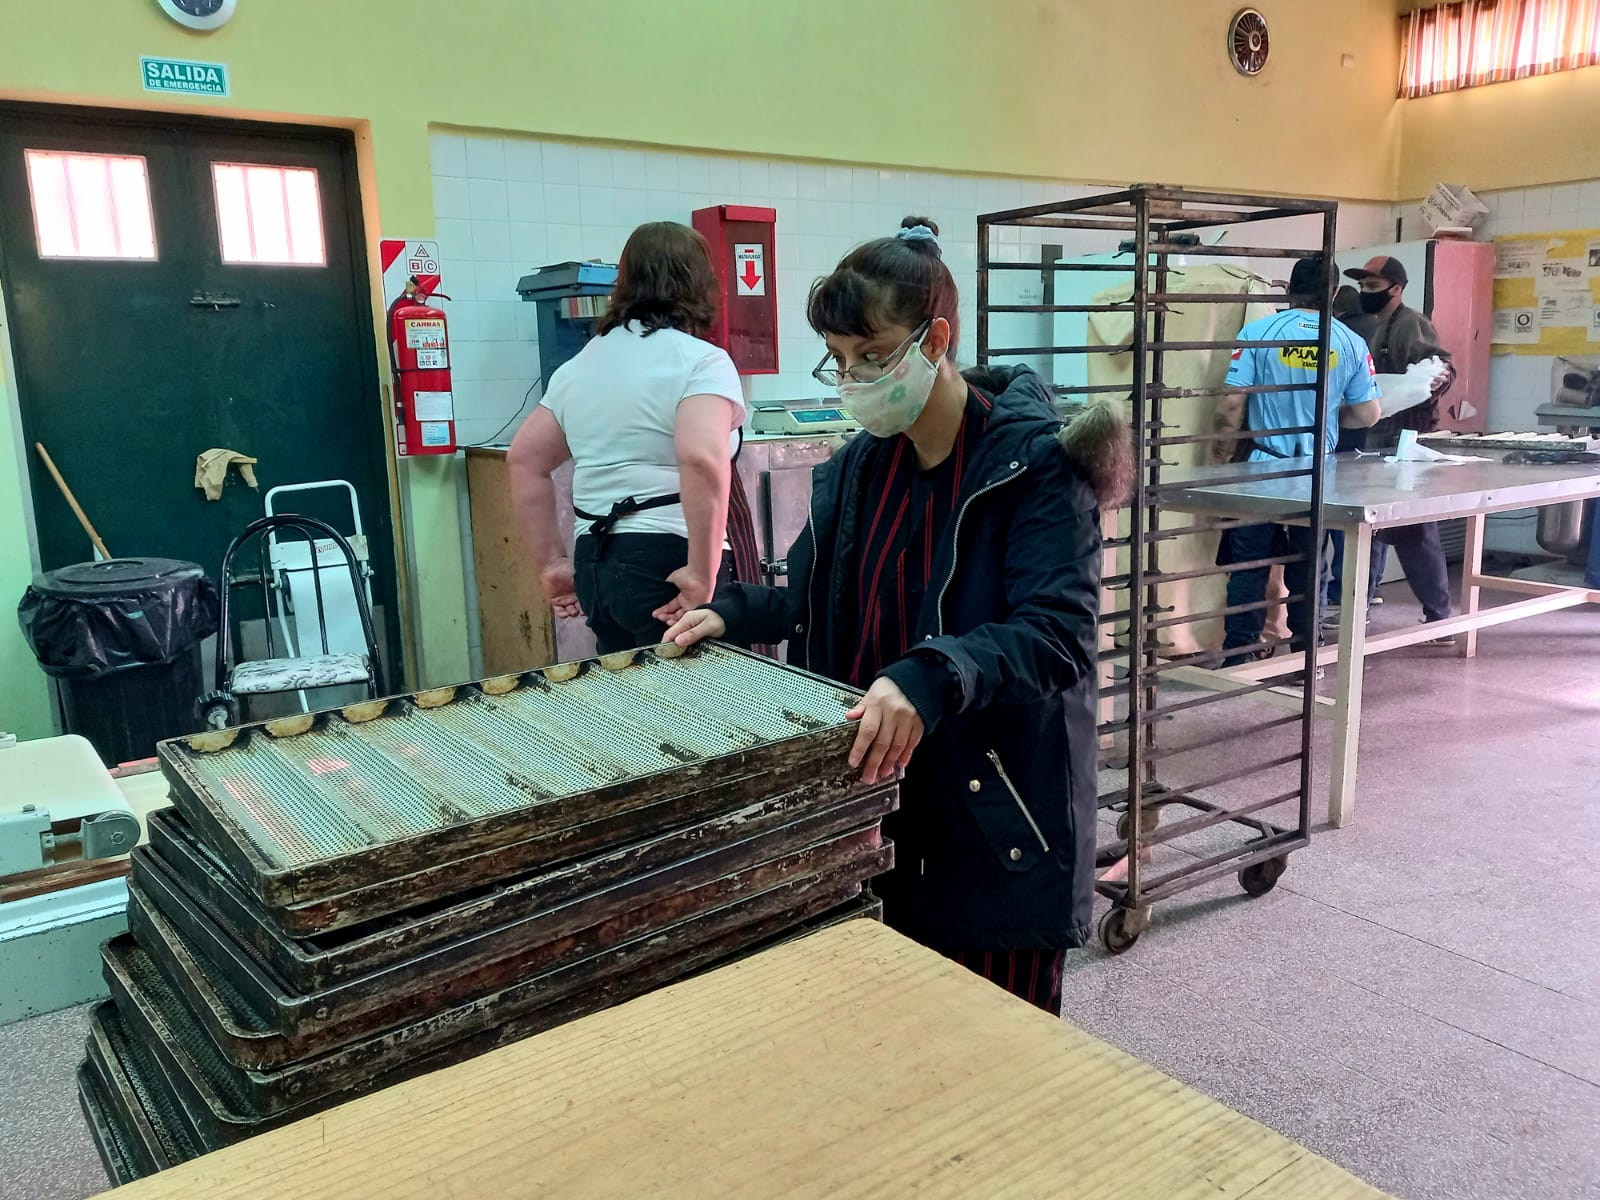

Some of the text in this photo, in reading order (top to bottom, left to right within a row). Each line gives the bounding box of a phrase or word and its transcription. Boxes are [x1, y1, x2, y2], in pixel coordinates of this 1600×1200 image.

[146, 62, 220, 83] SALIDA
[149, 78, 222, 92] DE EMERGENCIA
